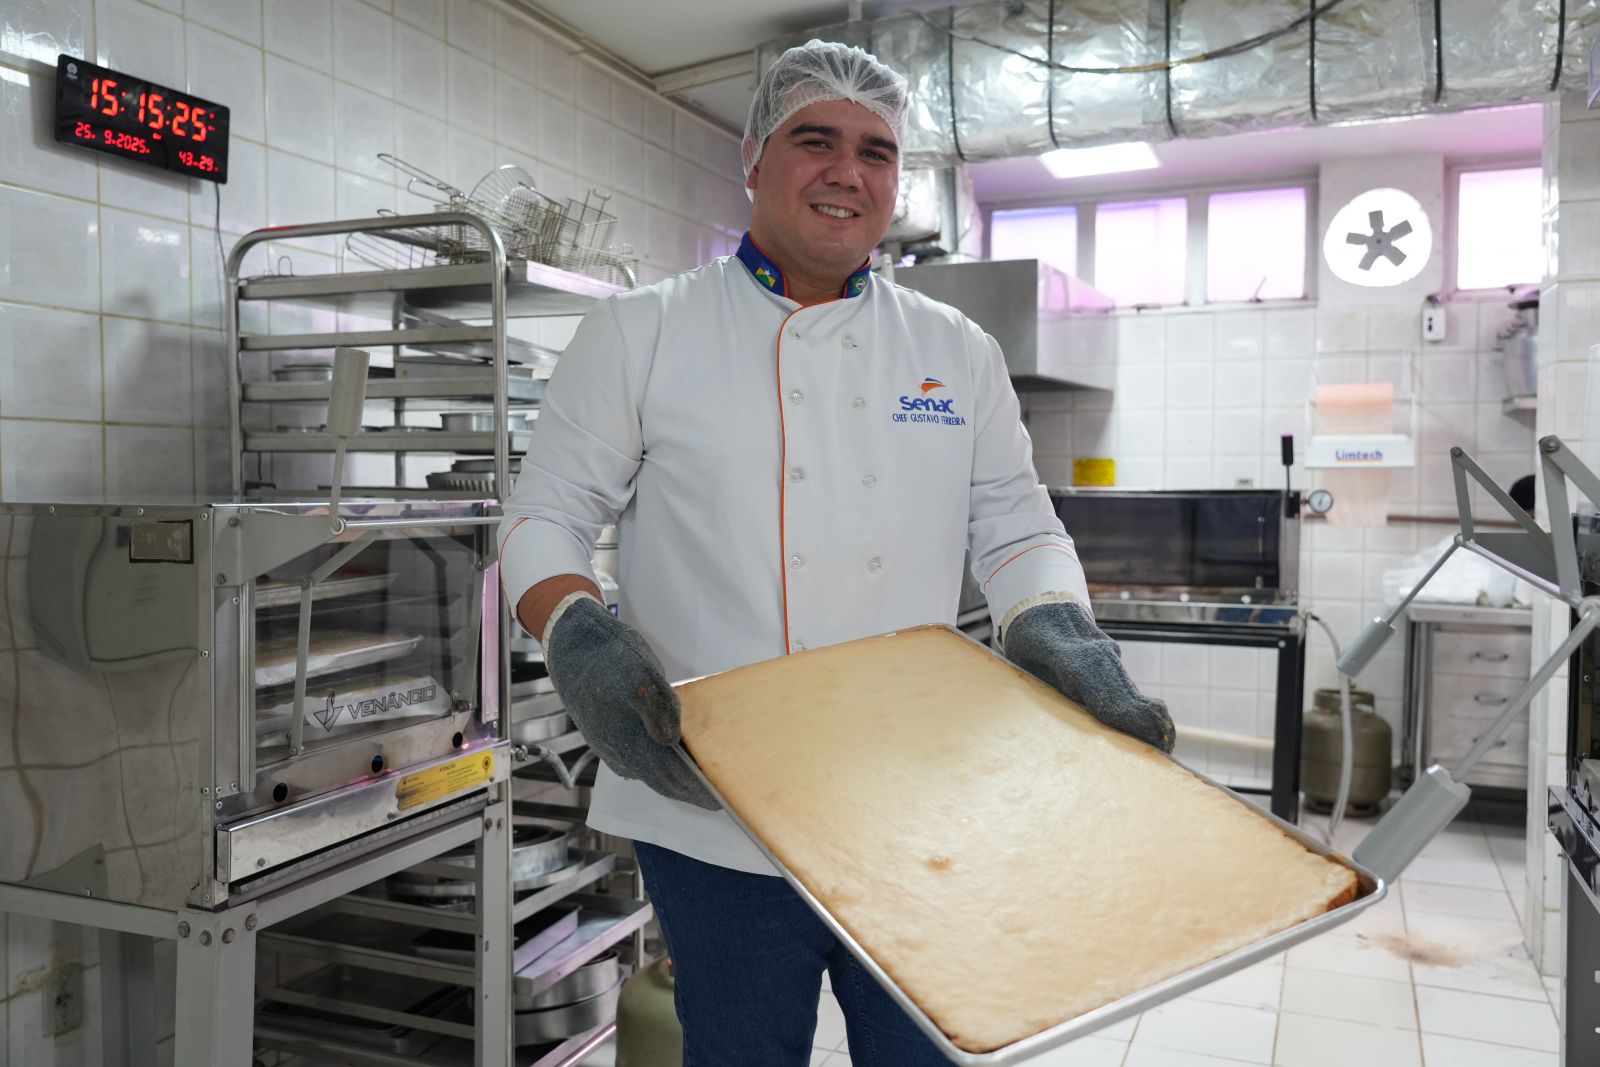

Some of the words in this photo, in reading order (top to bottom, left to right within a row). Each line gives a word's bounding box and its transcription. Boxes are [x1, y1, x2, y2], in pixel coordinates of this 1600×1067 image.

[899, 395, 954, 414] Senac
[892, 413, 908, 423] CHEF
[910, 413, 939, 424] GUSTAVO
[347, 685, 437, 719] VENÂNCIO
